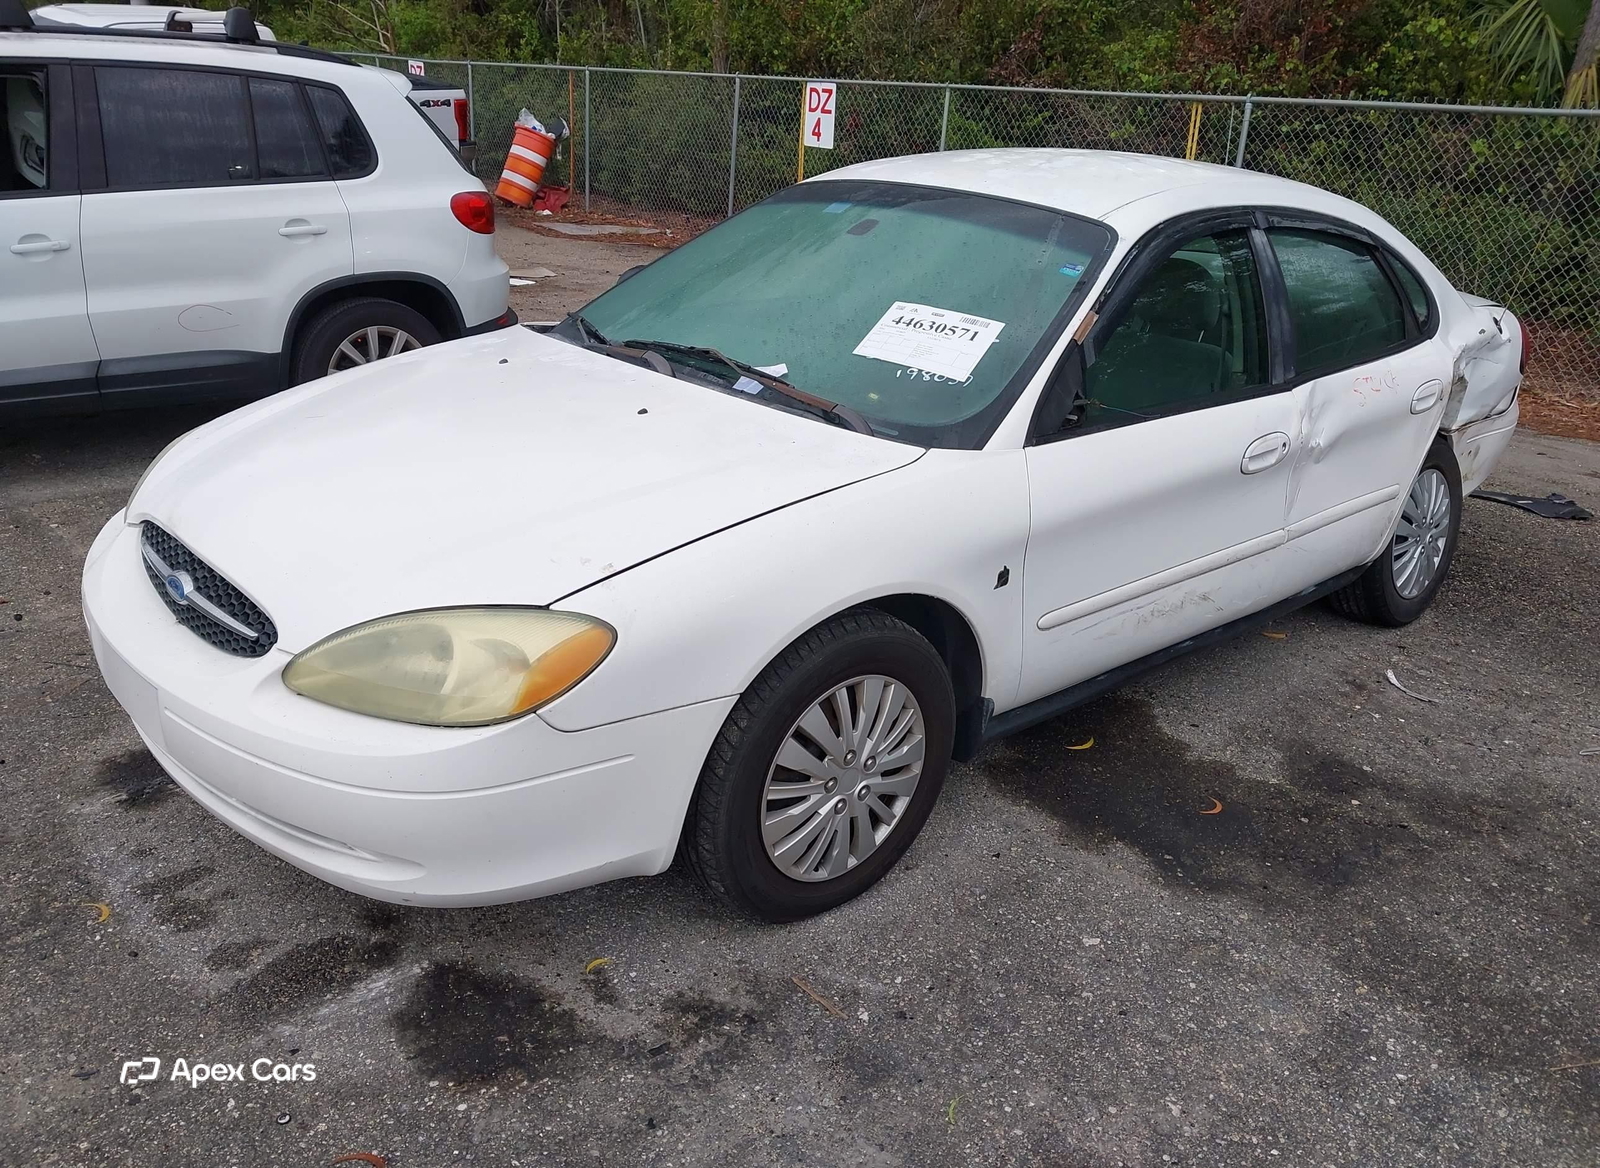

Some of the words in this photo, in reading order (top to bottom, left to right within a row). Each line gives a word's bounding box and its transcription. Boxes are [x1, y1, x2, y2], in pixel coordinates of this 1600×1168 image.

[808, 87, 833, 114] DZ
[811, 117, 821, 142] 4
[891, 315, 980, 341] 44630571
[896, 368, 973, 387] 1980
